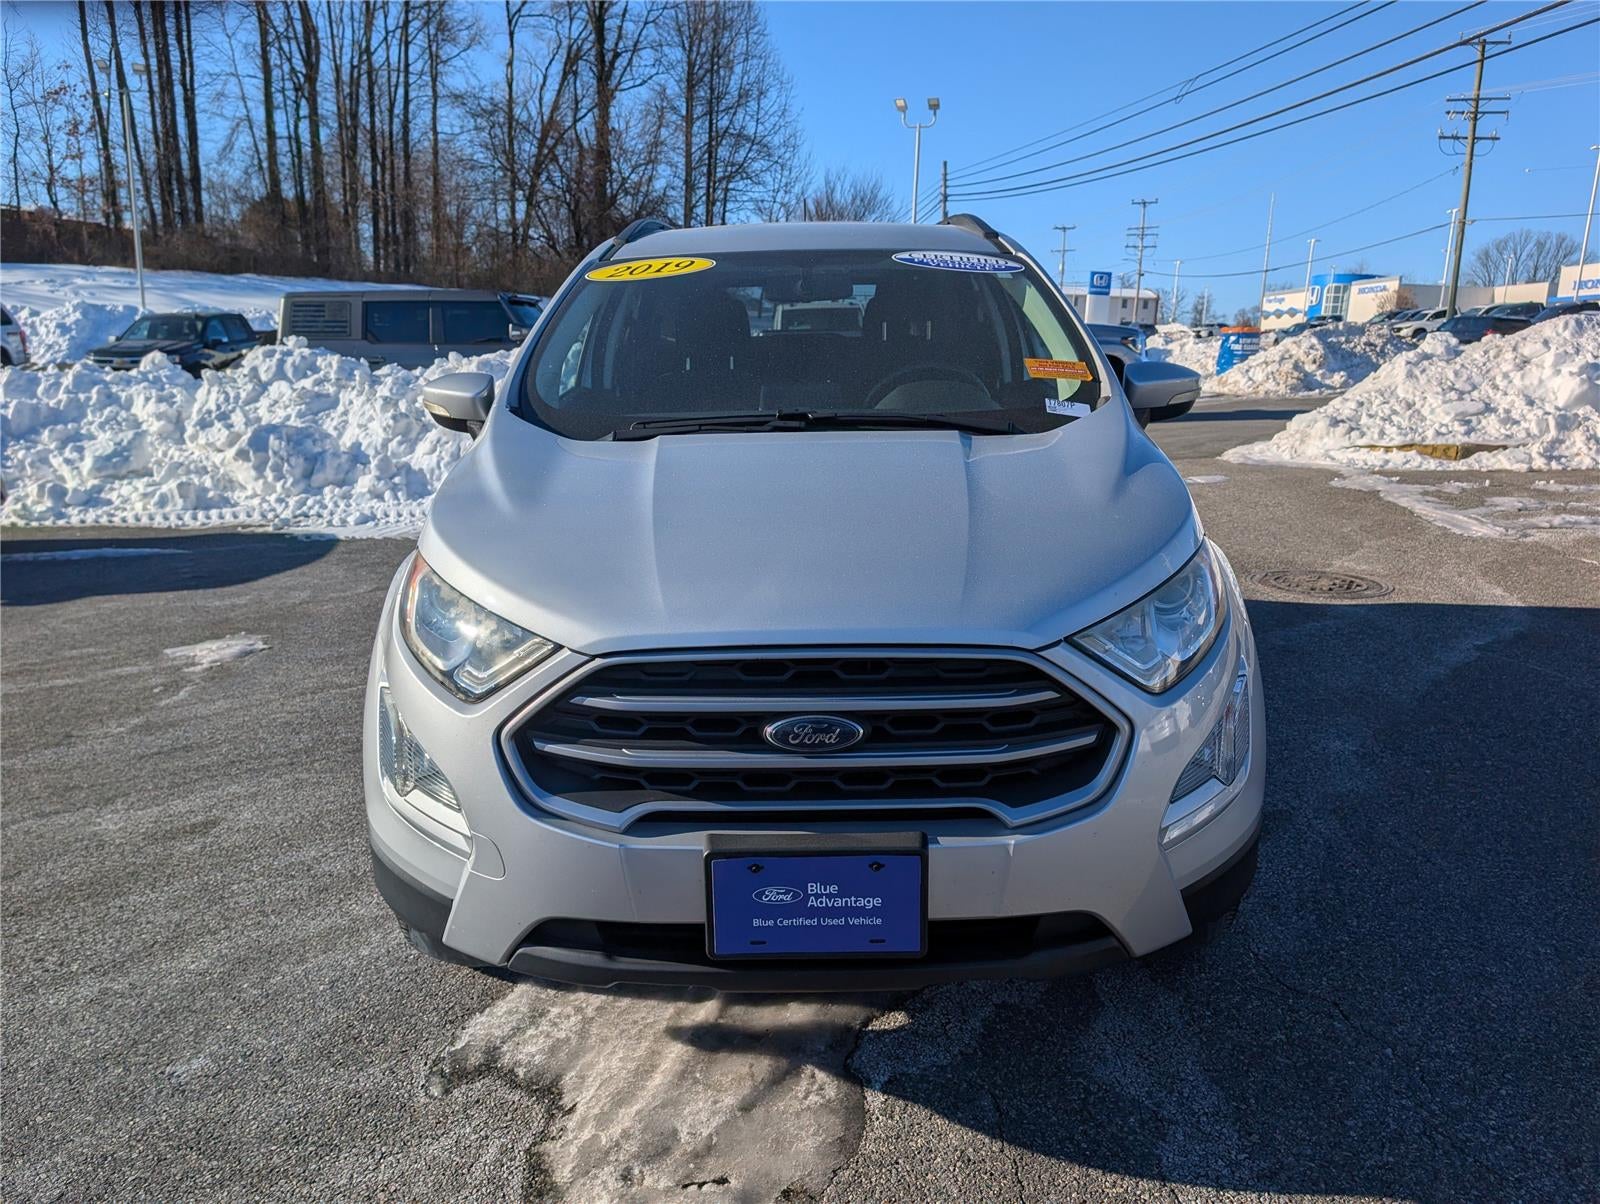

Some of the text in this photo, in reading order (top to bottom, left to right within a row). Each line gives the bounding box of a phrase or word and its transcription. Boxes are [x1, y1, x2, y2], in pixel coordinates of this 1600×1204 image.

[605, 260, 696, 279] 2019
[788, 722, 841, 744] Ford
[762, 882, 839, 902] Ford Blue
[807, 896, 882, 909] Advantage
[752, 916, 882, 927] Blue Certified Used Vehicle
